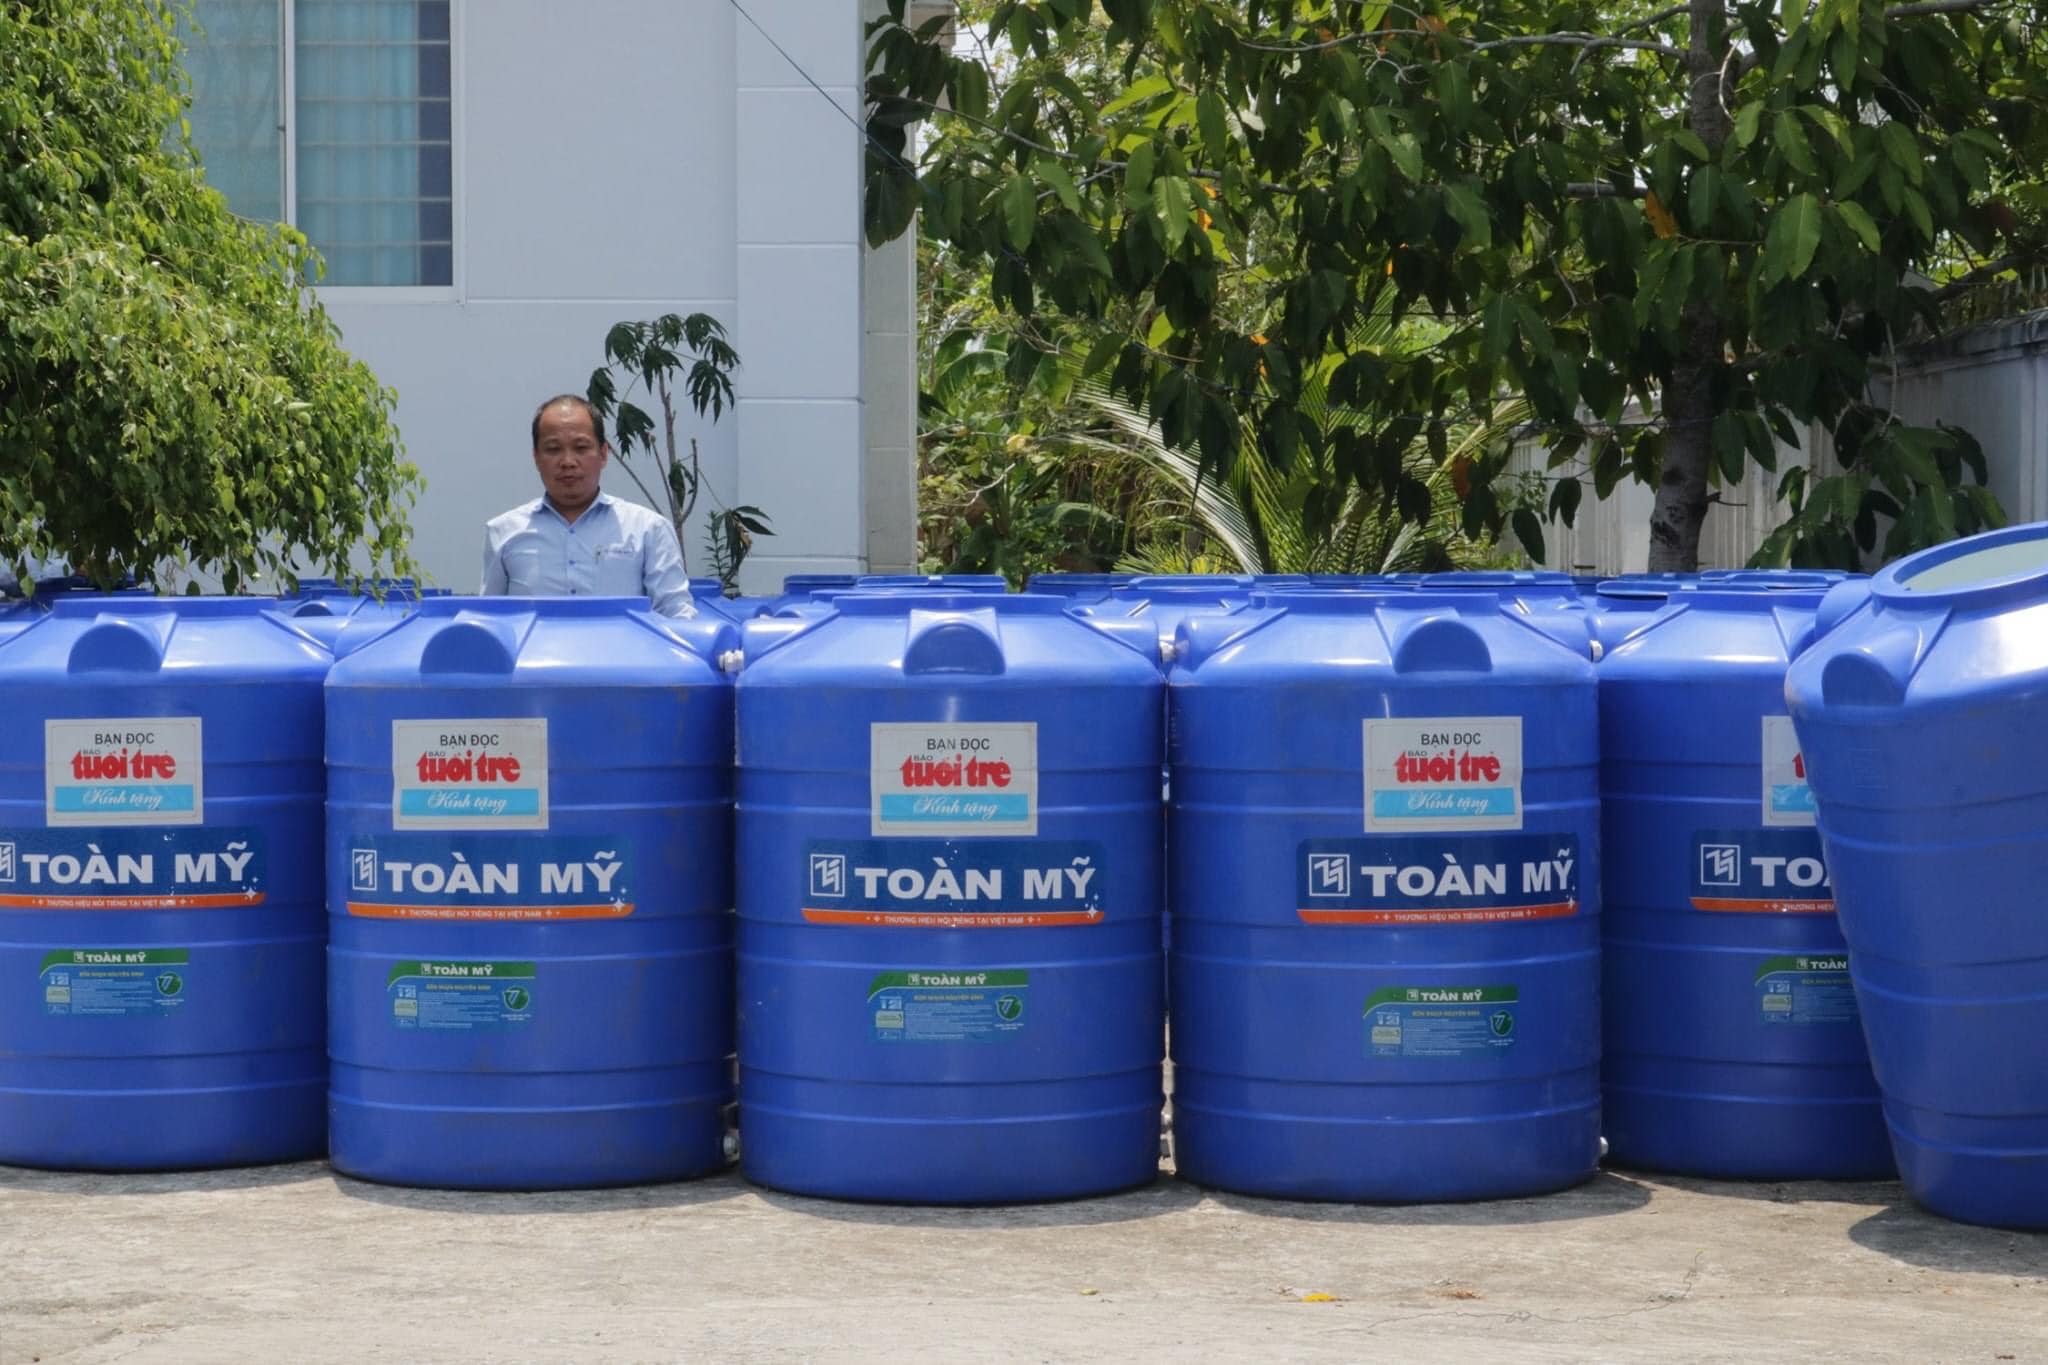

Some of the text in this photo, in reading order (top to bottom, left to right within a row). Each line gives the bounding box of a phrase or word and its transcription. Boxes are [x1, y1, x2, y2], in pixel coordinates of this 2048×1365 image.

[95, 733, 154, 747] BẠN ĐỌC
[440, 734, 499, 748] BẠN ĐỌC
[927, 738, 990, 752] BẠN ĐỌC
[1421, 732, 1481, 748] BẠN ĐỌC
[82, 787, 162, 809] Kính tặng
[428, 790, 507, 814] Kính tặng
[913, 796, 998, 819] Kính tặng
[1408, 790, 1488, 814] Kính tặng
[22, 842, 254, 884] TOÀN MỸ
[384, 850, 622, 894] TOÀN MỸ
[1361, 848, 1573, 897] TOÀN MỸ
[1751, 857, 1832, 887] TO
[855, 857, 1095, 900] TOÀN MỸ
[86, 952, 146, 962] TOÀN MỸ
[1810, 958, 1846, 970] TOÀN
[433, 964, 493, 975] TOÀN MỸ
[922, 974, 987, 985] TOÀN MỸ
[1420, 990, 1482, 1000] TOÀN MỸ
